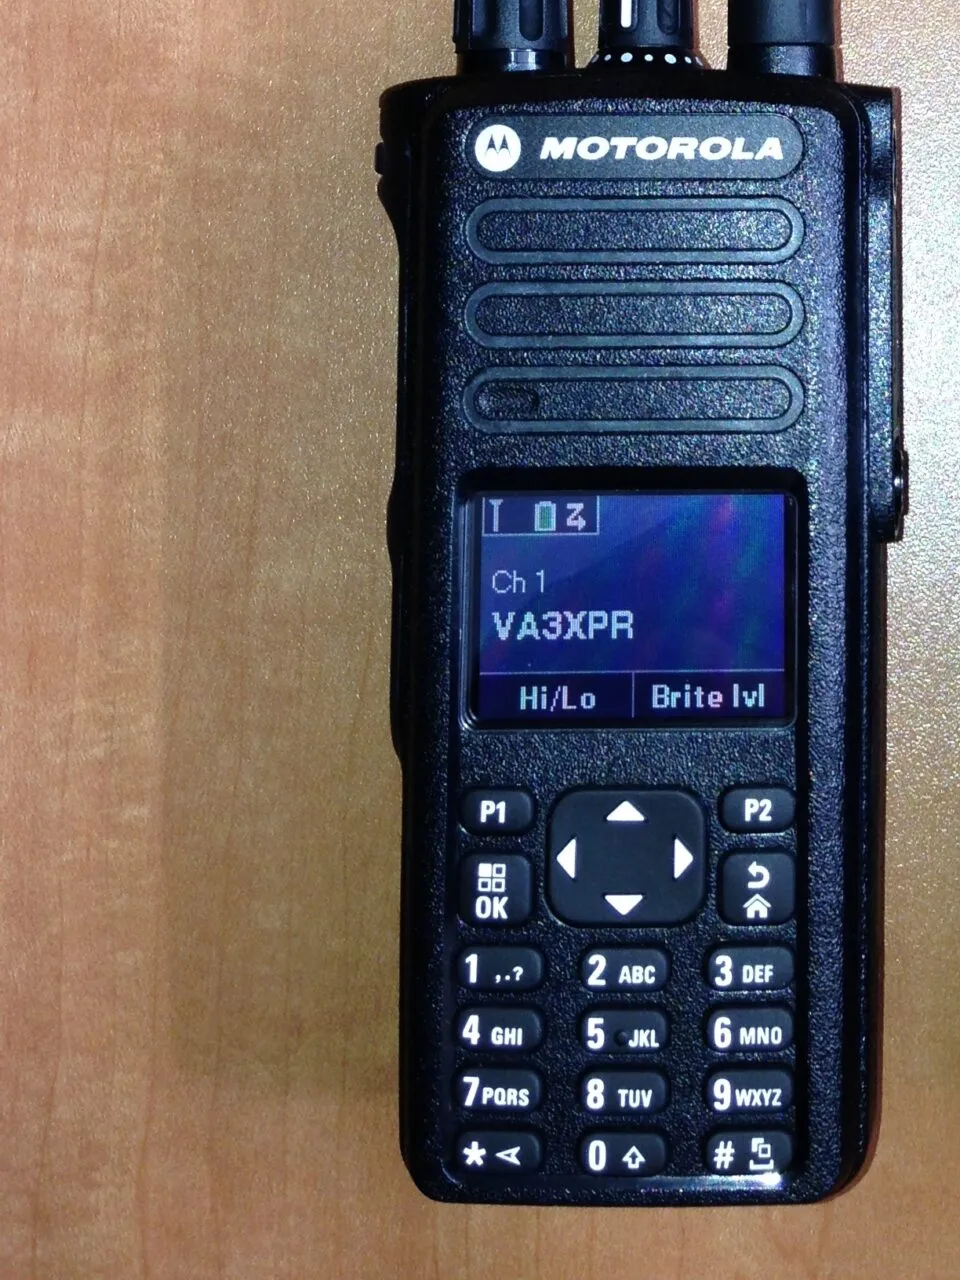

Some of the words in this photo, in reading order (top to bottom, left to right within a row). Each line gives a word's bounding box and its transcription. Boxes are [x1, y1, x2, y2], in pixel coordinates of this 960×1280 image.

[539, 136, 784, 161] MOTOROLA
[492, 570, 526, 594] Ch
[536, 570, 544, 593] 1
[492, 611, 634, 641] VA3XPR
[519, 685, 596, 712] Hi/Lo
[652, 684, 723, 708] Brite
[480, 800, 506, 824] P1
[744, 799, 772, 822] P2
[475, 896, 509, 920] OK
[464, 954, 479, 984] 1
[587, 954, 607, 987] 2
[618, 965, 656, 984] ABC
[714, 955, 733, 987] 3
[742, 965, 774, 983] DEF
[462, 1014, 480, 1045] 4
[491, 1027, 523, 1046] GHI
[586, 1018, 605, 1051] 5
[628, 1029, 660, 1048] JKL
[713, 1017, 732, 1049] 6
[739, 1026, 783, 1045] MNO
[463, 1076, 480, 1107] 7
[481, 1087, 530, 1106] PQRS
[586, 1078, 605, 1110] 8
[618, 1089, 653, 1108] TUV
[713, 1078, 732, 1111] 9
[735, 1088, 783, 1106] WXYZ
